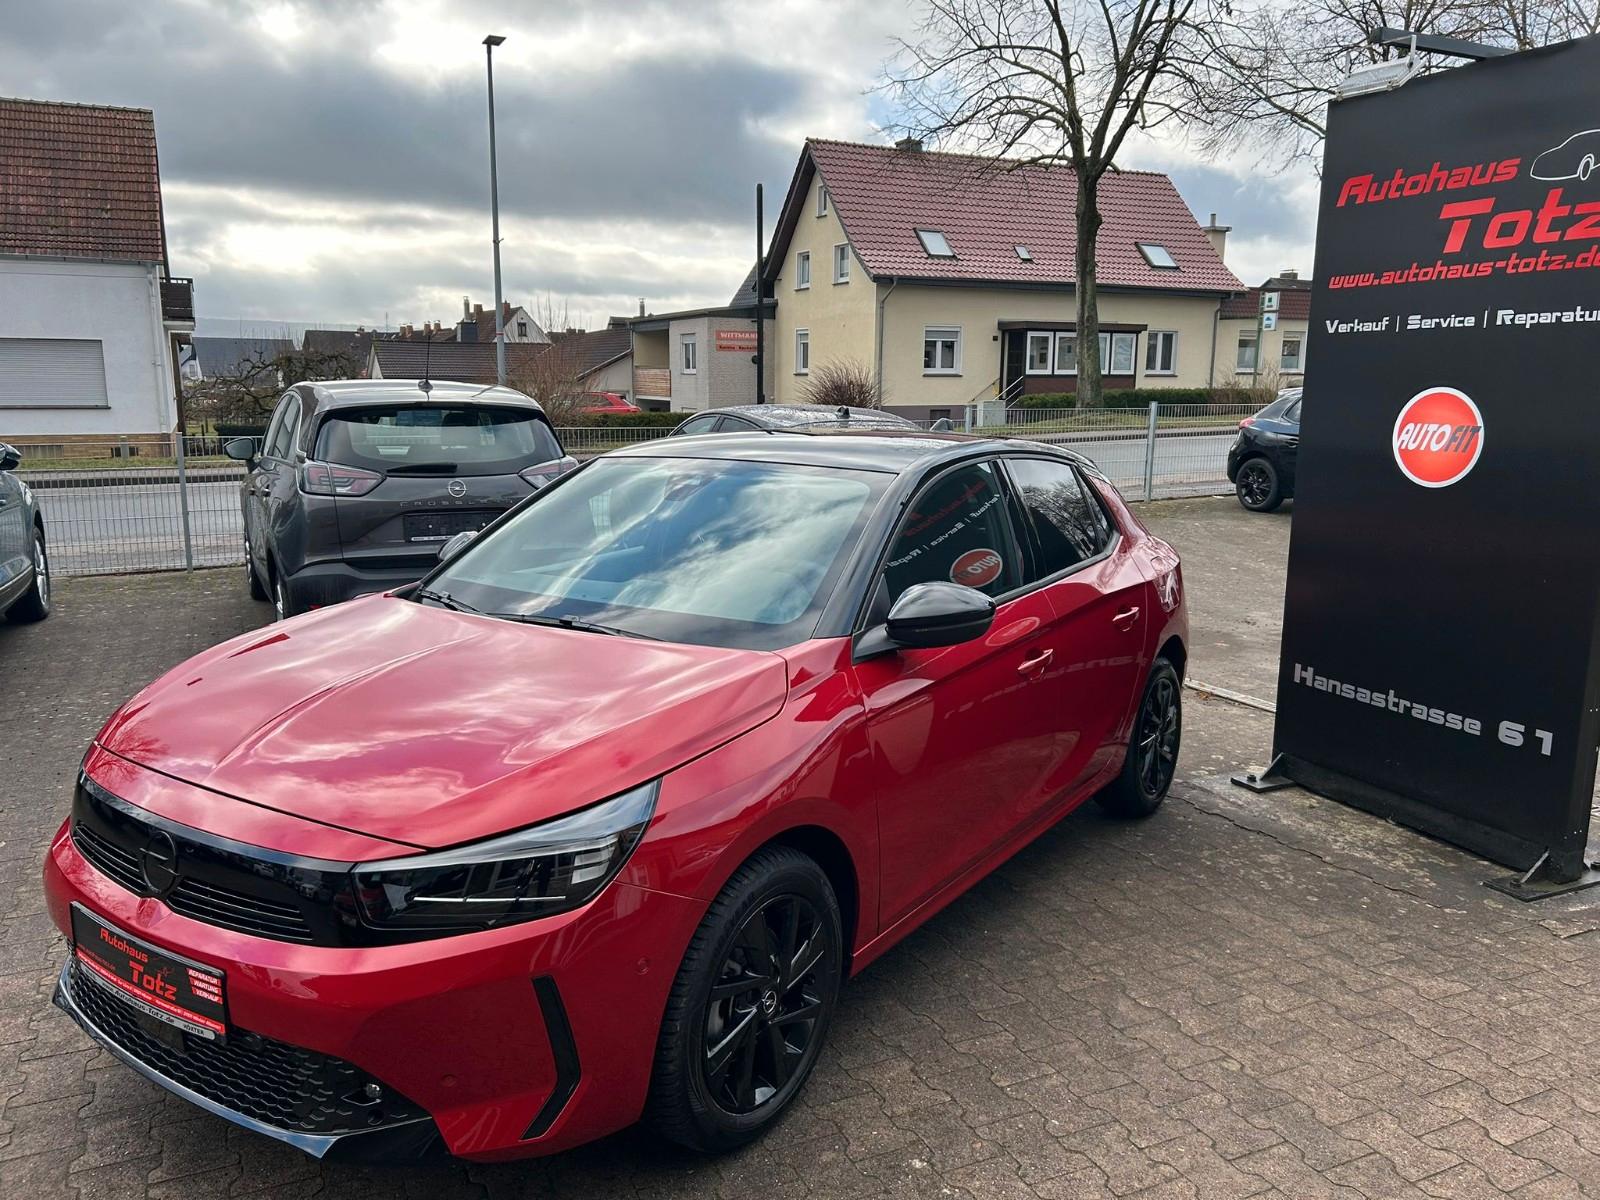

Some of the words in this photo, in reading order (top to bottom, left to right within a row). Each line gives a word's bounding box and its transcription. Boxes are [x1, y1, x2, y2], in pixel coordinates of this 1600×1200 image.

[1335, 157, 1521, 208] Autohaus
[1439, 187, 1600, 254] Totz
[1325, 316, 1390, 333] Verkauf
[1406, 314, 1476, 330] Service
[1396, 422, 1482, 454] AUTOFIT
[1293, 663, 1482, 736] Hansastrasse
[100, 928, 148, 963] Autohaus
[129, 961, 177, 1001] Totz
